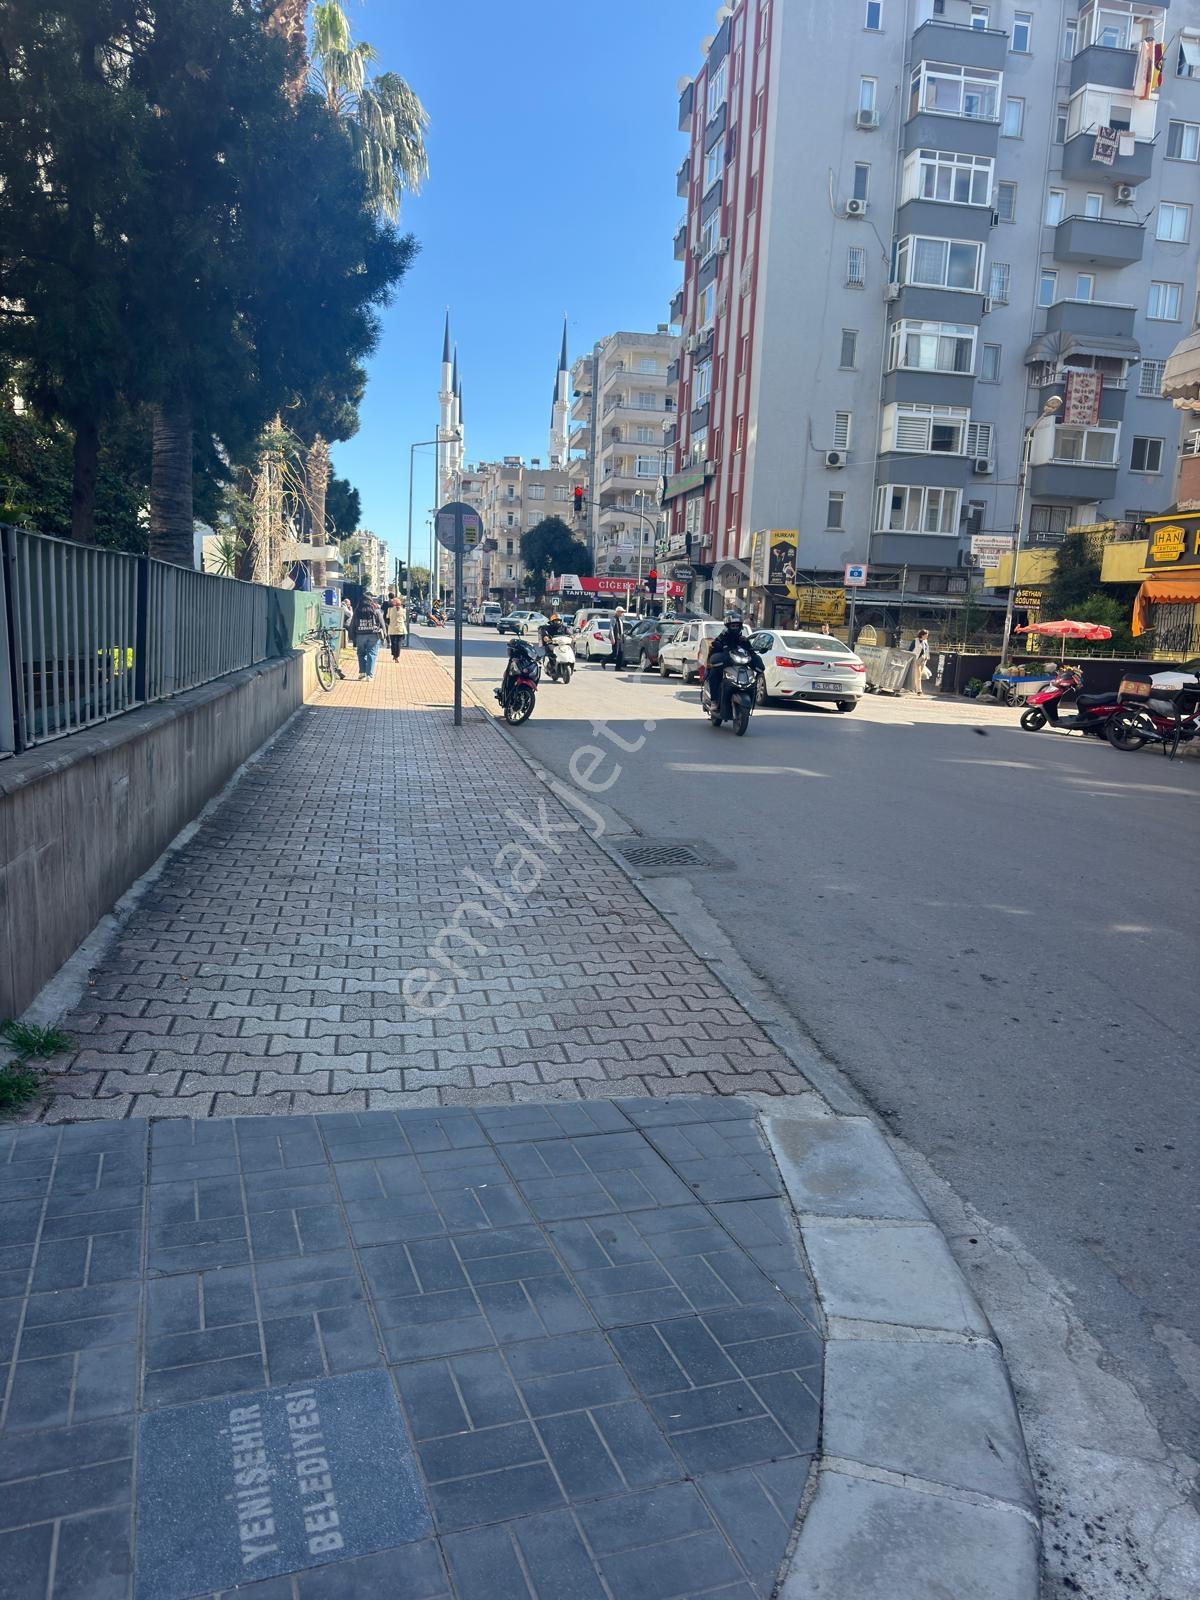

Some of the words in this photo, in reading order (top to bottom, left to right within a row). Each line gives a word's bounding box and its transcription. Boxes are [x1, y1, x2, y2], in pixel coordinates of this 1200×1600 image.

[1158, 532, 1180, 544] HAN
[1015, 597, 1041, 605] SOĞUTMA
[219, 1403, 279, 1566] YENİŞEHİR
[274, 1388, 345, 1556] BELEDİYESİ
